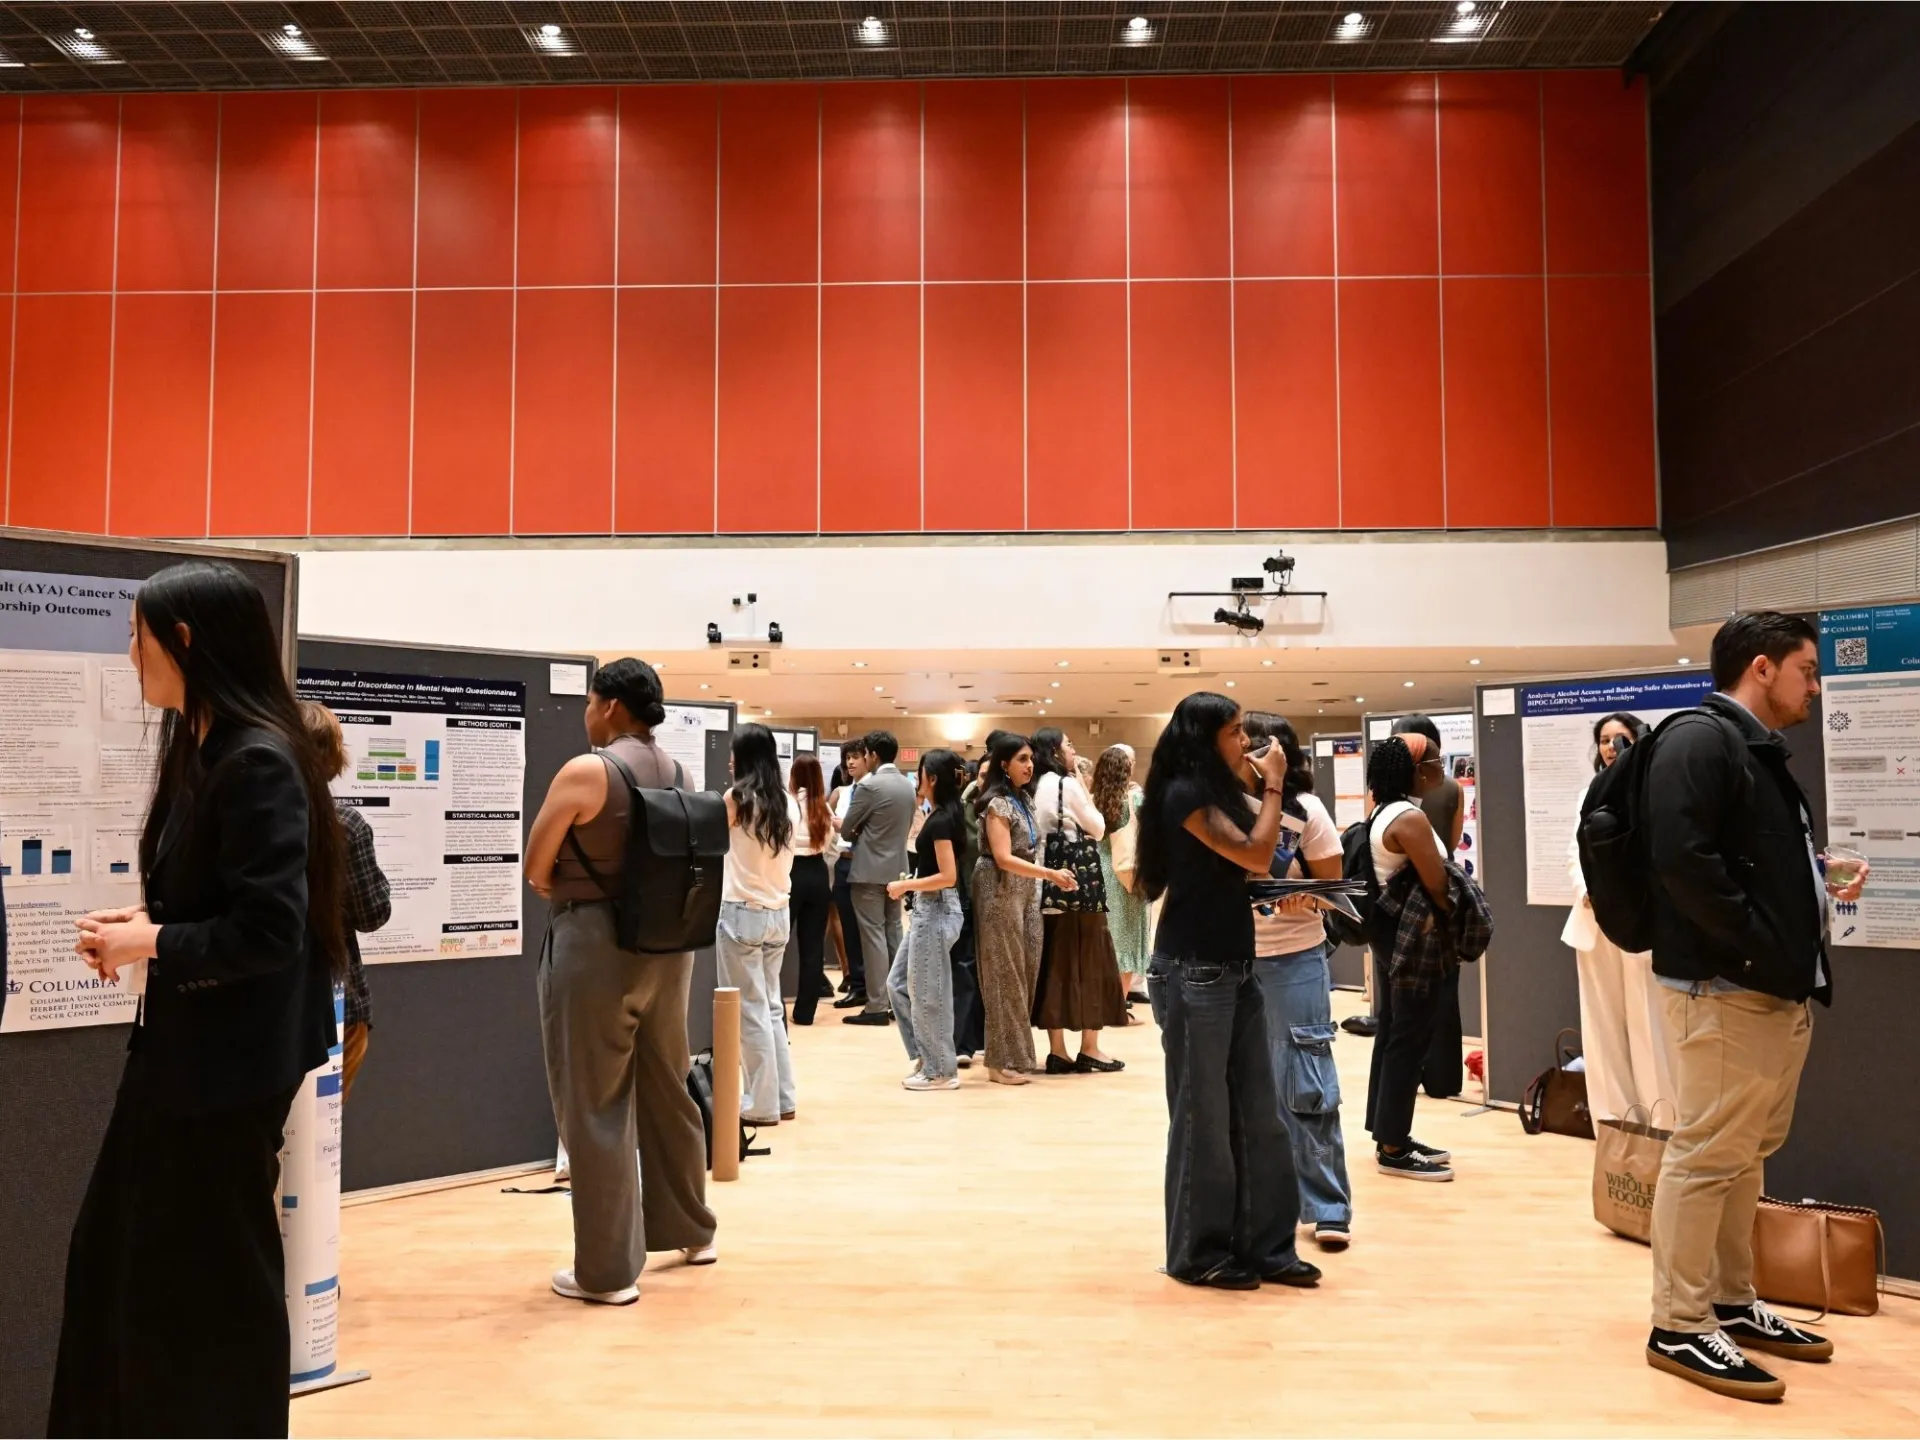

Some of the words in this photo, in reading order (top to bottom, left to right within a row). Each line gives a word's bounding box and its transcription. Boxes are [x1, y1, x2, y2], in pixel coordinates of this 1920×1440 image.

[18, 583, 63, 597] (AYA)
[68, 586, 114, 599] Cancer
[45, 603, 111, 617] Outcomes
[1830, 612, 1869, 621] COLUMBIA
[1830, 625, 1869, 634] COLUMBIA
[357, 681, 405, 690] Discordance
[415, 684, 440, 693] Mental
[441, 685, 464, 694] Health
[465, 687, 517, 697] Questionnaires
[1556, 689, 1580, 697] Alcohol
[1616, 685, 1643, 693] Building
[1661, 681, 1701, 690] Alternatives
[1701, 680, 1712, 688] for
[1549, 697, 1577, 705] LGBTQ+
[1579, 695, 1597, 703] Youth
[1606, 694, 1635, 702] Brooklyn
[348, 715, 374, 723] DESIGN
[440, 943, 462, 953] NYC
[29, 979, 117, 993] COLUMBIA
[30, 997, 75, 1005] COLUMBIA
[77, 993, 126, 1002] UNIVERSITY
[30, 1005, 67, 1013] HERBERT
[71, 1002, 101, 1010] IRVING
[30, 1013, 65, 1021] CANCER
[67, 1010, 100, 1018] CENTER
[1604, 1170, 1657, 1197] WHOLE
[1608, 1186, 1655, 1210] FOODS
